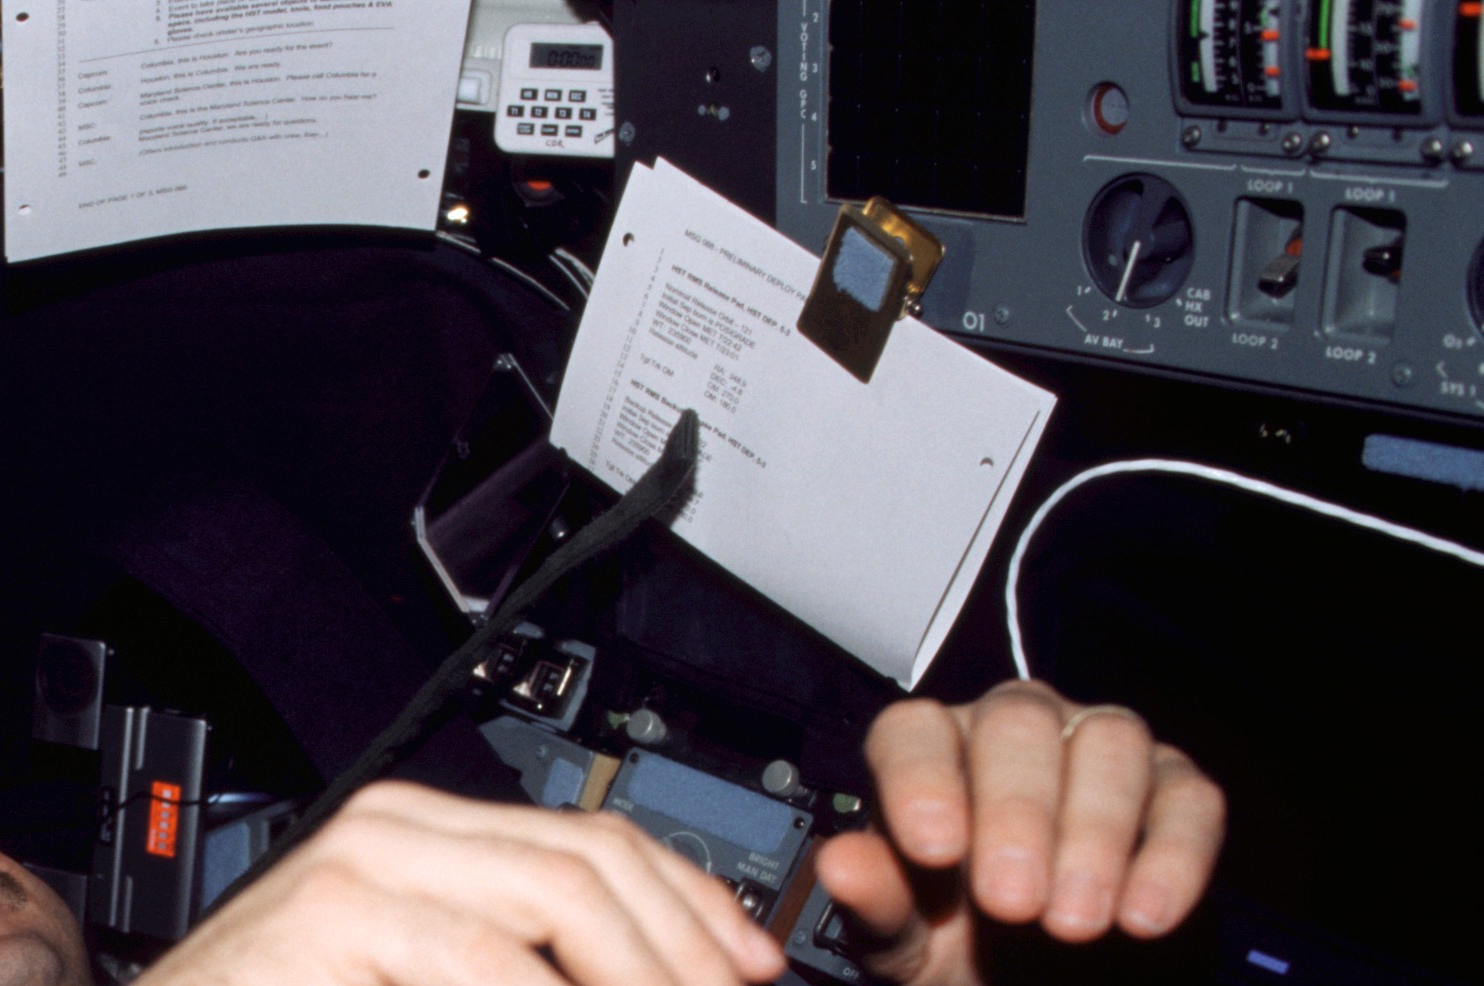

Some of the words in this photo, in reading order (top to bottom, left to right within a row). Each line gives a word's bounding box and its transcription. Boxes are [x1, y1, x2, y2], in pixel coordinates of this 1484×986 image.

[813, 13, 819, 23] 2
[800, 23, 808, 81] VOTING
[812, 63, 818, 73] 3
[799, 89, 808, 119] GPC
[811, 112, 817, 121] 4
[811, 161, 816, 171] 5
[1247, 179, 1283, 193] LOOP
[1344, 187, 1385, 202] LOOP
[719, 248, 766, 278] PRELIMINARY
[766, 274, 796, 295] DEPLOY
[671, 265, 686, 276] HST
[687, 273, 703, 286] RMS
[704, 282, 731, 301] Release
[1187, 287, 1211, 300] CAB
[1185, 301, 1203, 312] HX
[1102, 310, 1110, 321] 2
[1153, 317, 1161, 328] 3
[1184, 314, 1209, 327] OUT
[1084, 334, 1100, 345] AV
[1102, 336, 1124, 349] BAY
[1231, 332, 1269, 347] LOOP
[1271, 338, 1279, 349] 2
[1325, 346, 1364, 361] LOOP
[1368, 351, 1376, 364] 2
[749, 852, 779, 869] BRIGHT
[737, 862, 759, 877] MAN
[760, 870, 778, 884] DAY
